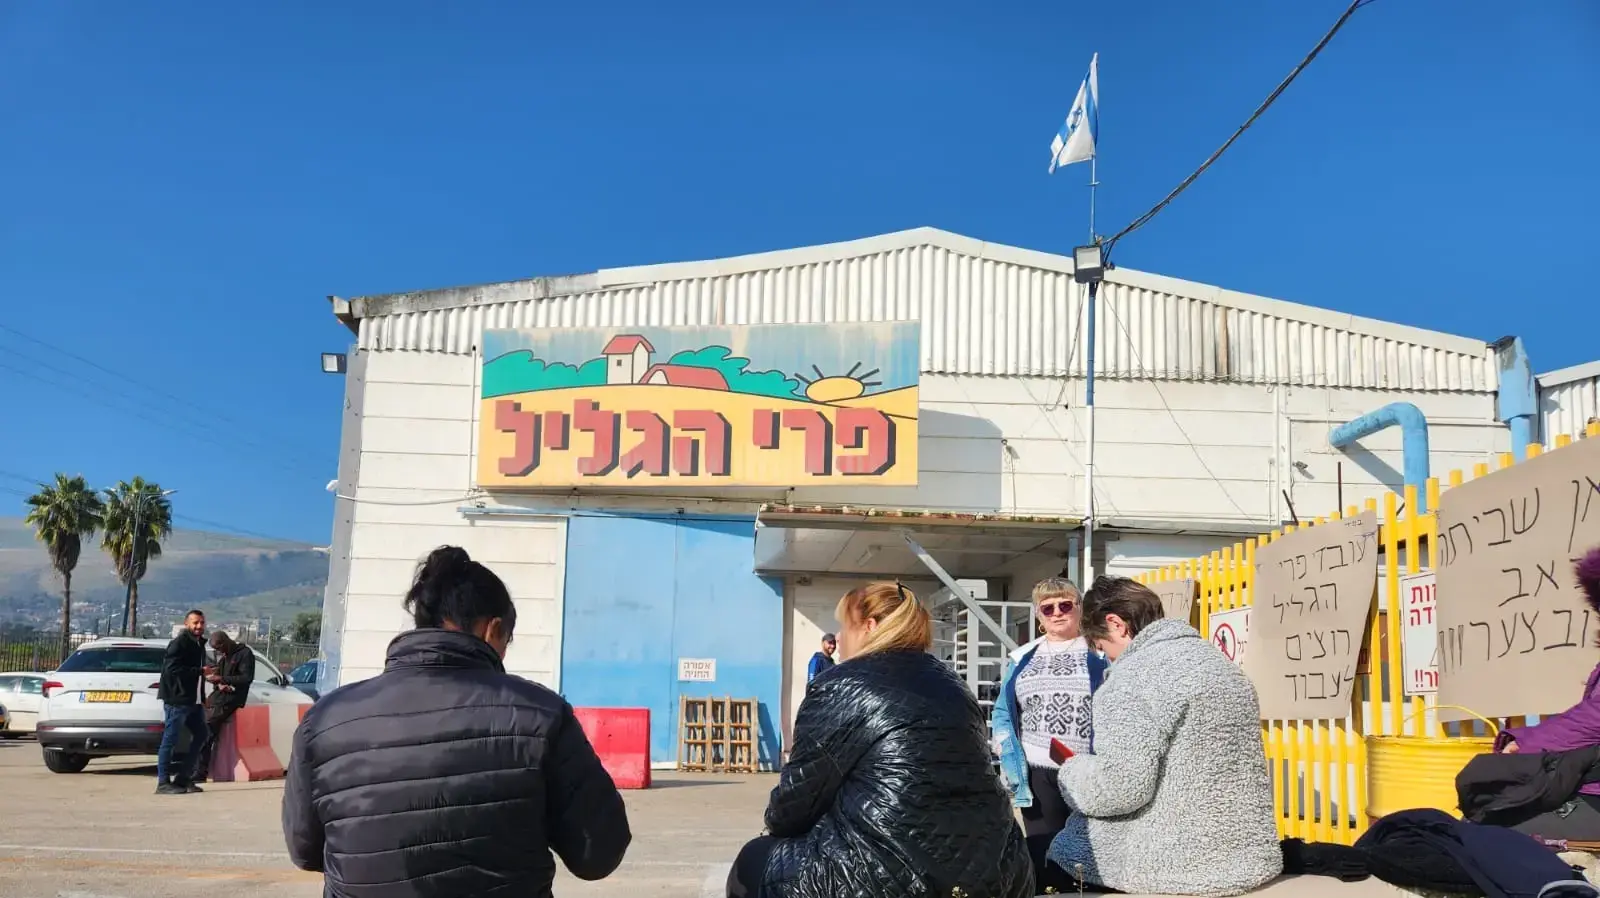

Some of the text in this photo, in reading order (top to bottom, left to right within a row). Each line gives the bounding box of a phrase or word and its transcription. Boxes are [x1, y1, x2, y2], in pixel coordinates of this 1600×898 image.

[495, 399, 896, 478] פרי הגליל
[1437, 487, 1540, 568] שביתה
[1279, 536, 1367, 581] עובדי פרי
[1273, 583, 1338, 624] הגליל
[1286, 629, 1350, 661] רוצים
[683, 661, 712, 670] אסורה
[684, 670, 710, 679] החניה
[1284, 665, 1354, 702] לעבוד
